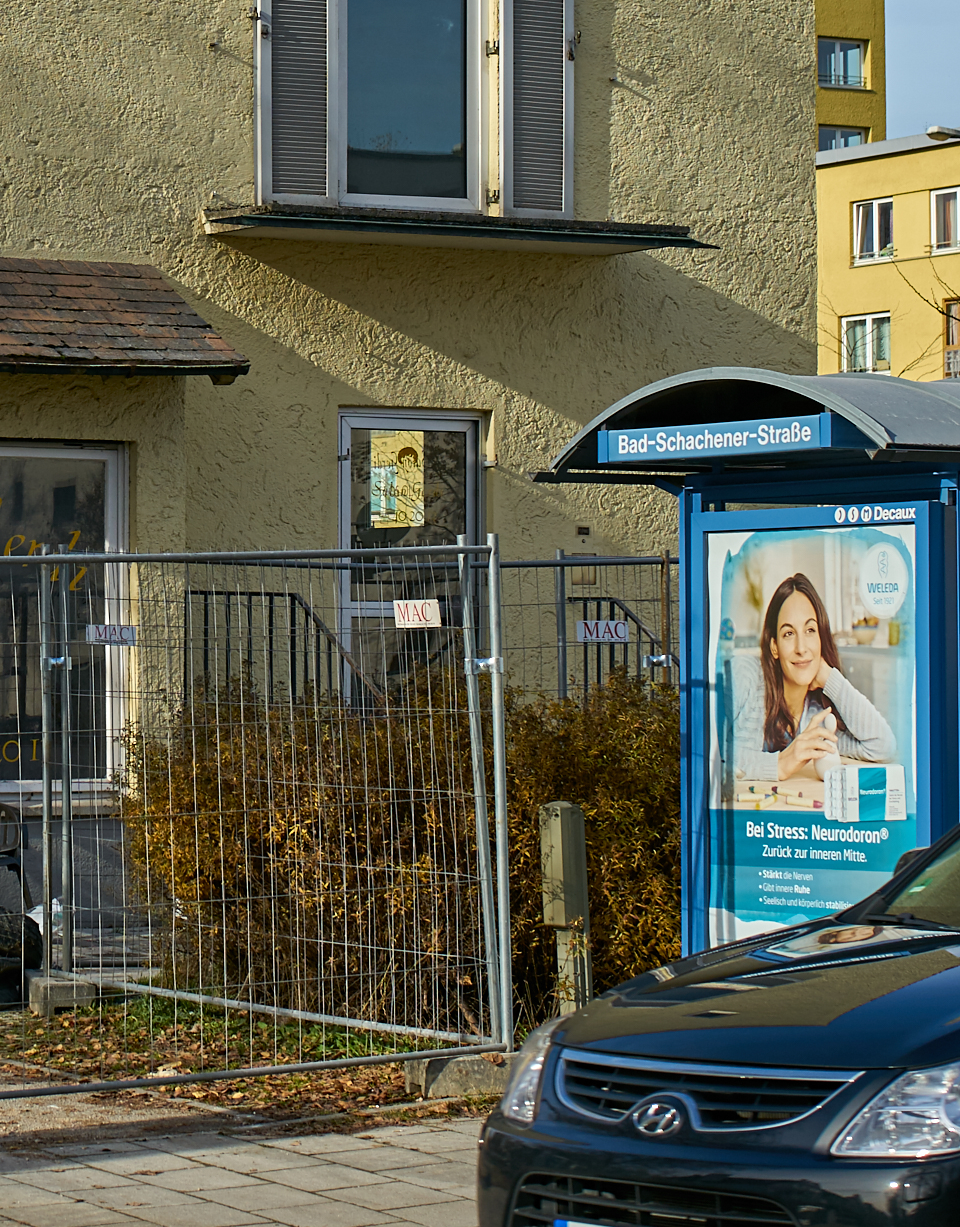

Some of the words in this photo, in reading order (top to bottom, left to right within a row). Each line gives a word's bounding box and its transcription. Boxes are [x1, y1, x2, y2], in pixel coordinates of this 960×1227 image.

[618, 422, 812, 454] Bad-Schachener-Straße
[873, 505, 916, 520] Decaux
[867, 583, 899, 593] WELEDA
[397, 602, 433, 622] MAC
[94, 625, 130, 641] MAC
[583, 621, 627, 639] MAC
[746, 821, 765, 838] Bei
[767, 822, 809, 840] Stress:
[811, 824, 889, 844] Neurodoron®
[762, 844, 792, 859] Zurück
[794, 848, 808, 859] zur
[810, 847, 842, 861] inneren
[843, 848, 868, 863] Mitte.
[762, 869, 783, 879] Stärkt
[783, 871, 792, 879] die
[793, 871, 813, 881] Nerven
[763, 883, 775, 892] Gibt
[776, 884, 793, 893] innere
[794, 884, 810, 894] Ruhe
[763, 895, 786, 905] Seelisch
[787, 898, 798, 906] und
[798, 899, 825, 909] körperlich
